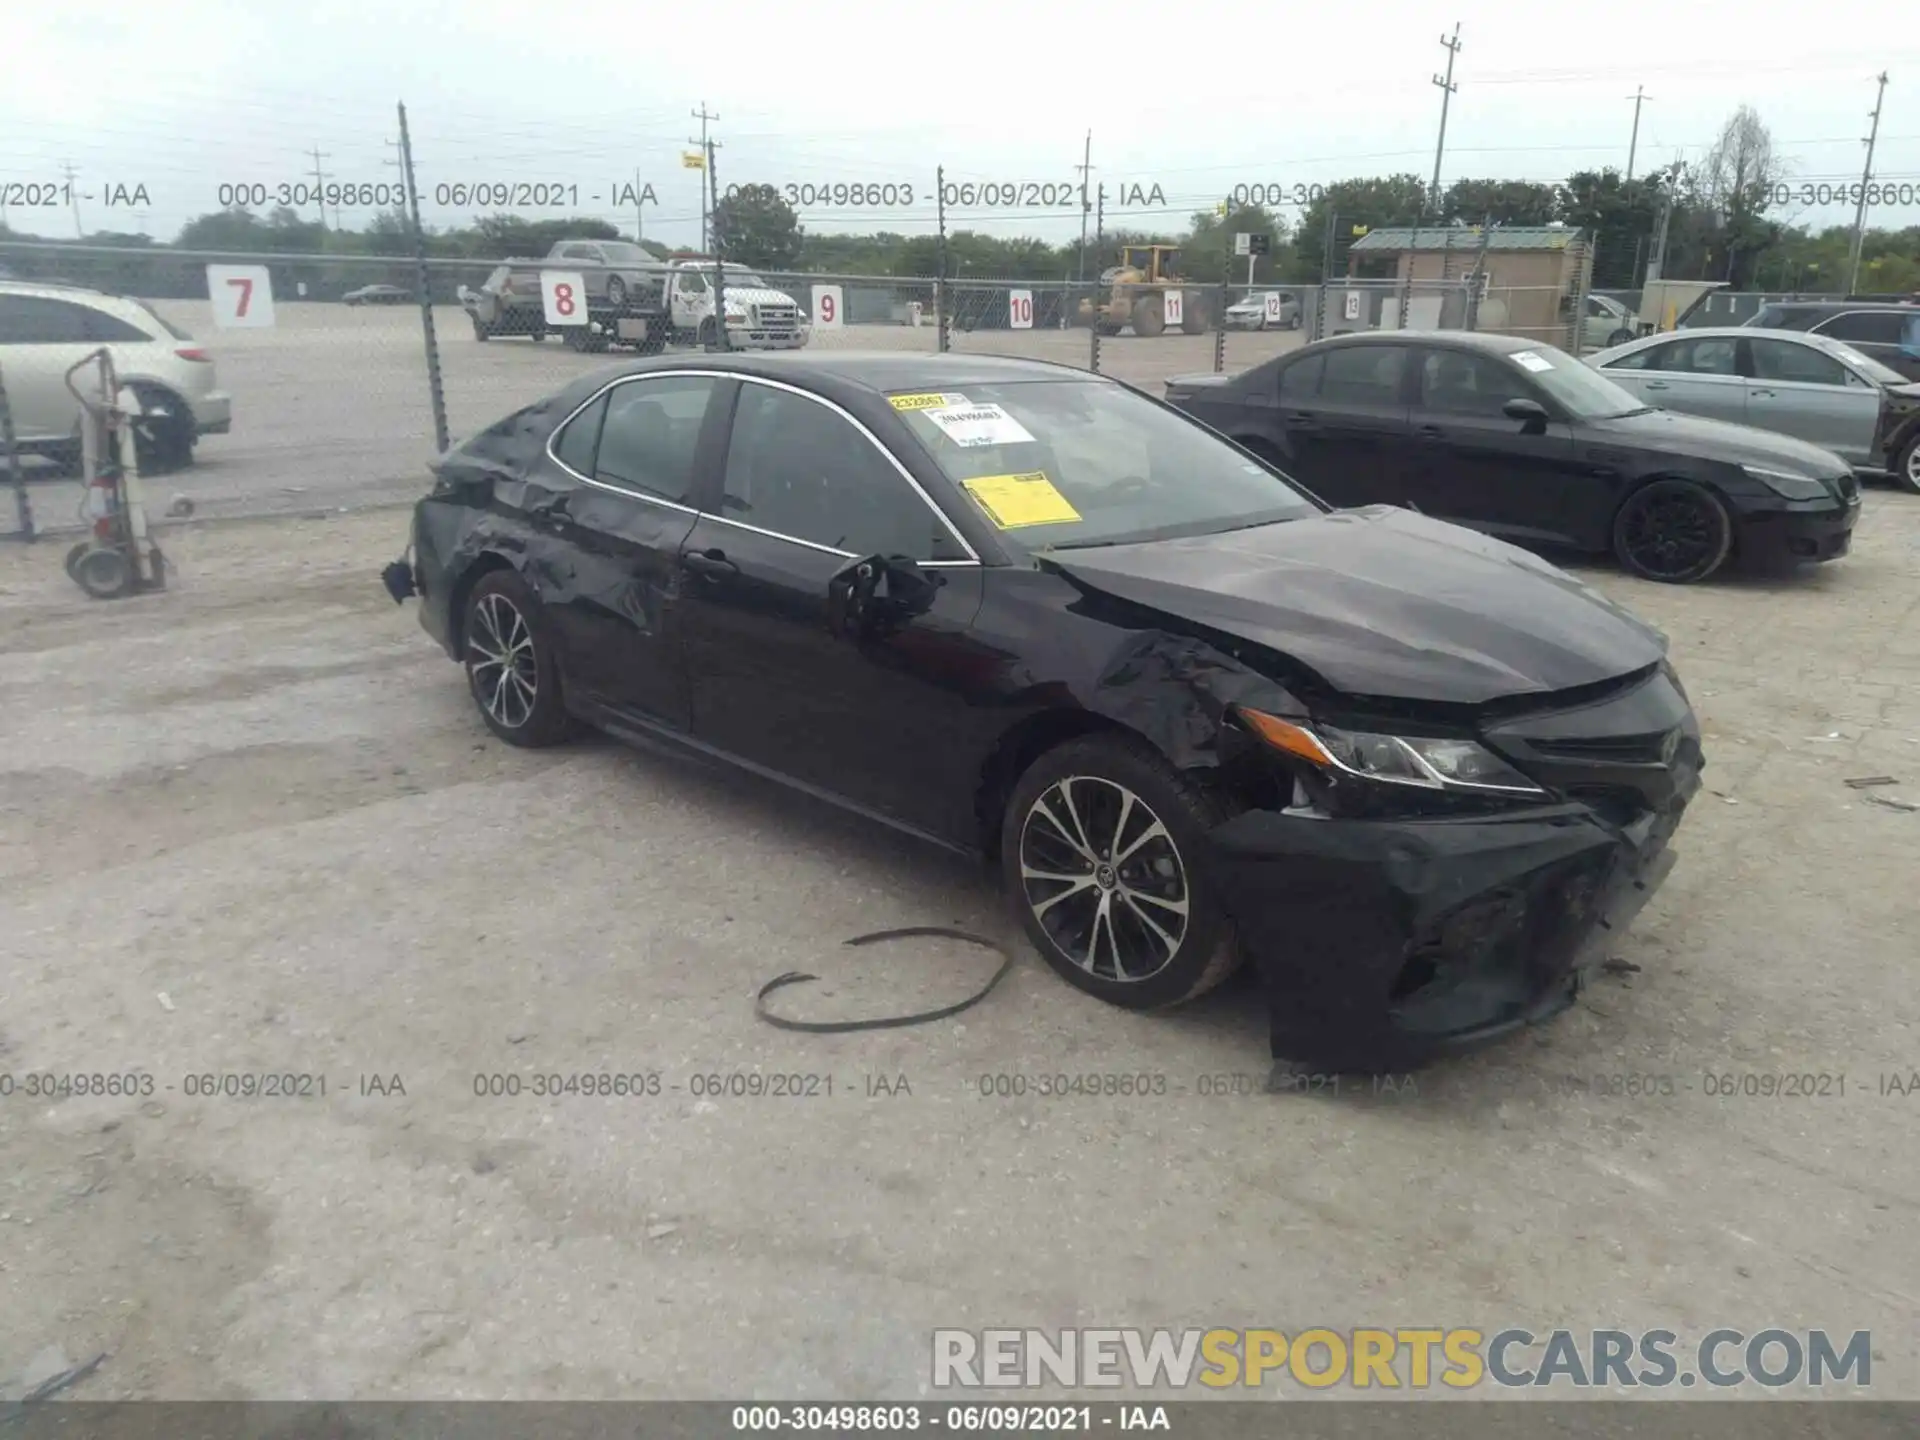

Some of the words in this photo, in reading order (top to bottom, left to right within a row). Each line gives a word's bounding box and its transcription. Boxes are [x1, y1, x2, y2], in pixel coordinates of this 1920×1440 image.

[226, 278, 252, 318] 7
[554, 283, 574, 316] 8
[820, 294, 835, 322] 9
[1011, 298, 1031, 323] 10
[1266, 300, 1280, 316] 12
